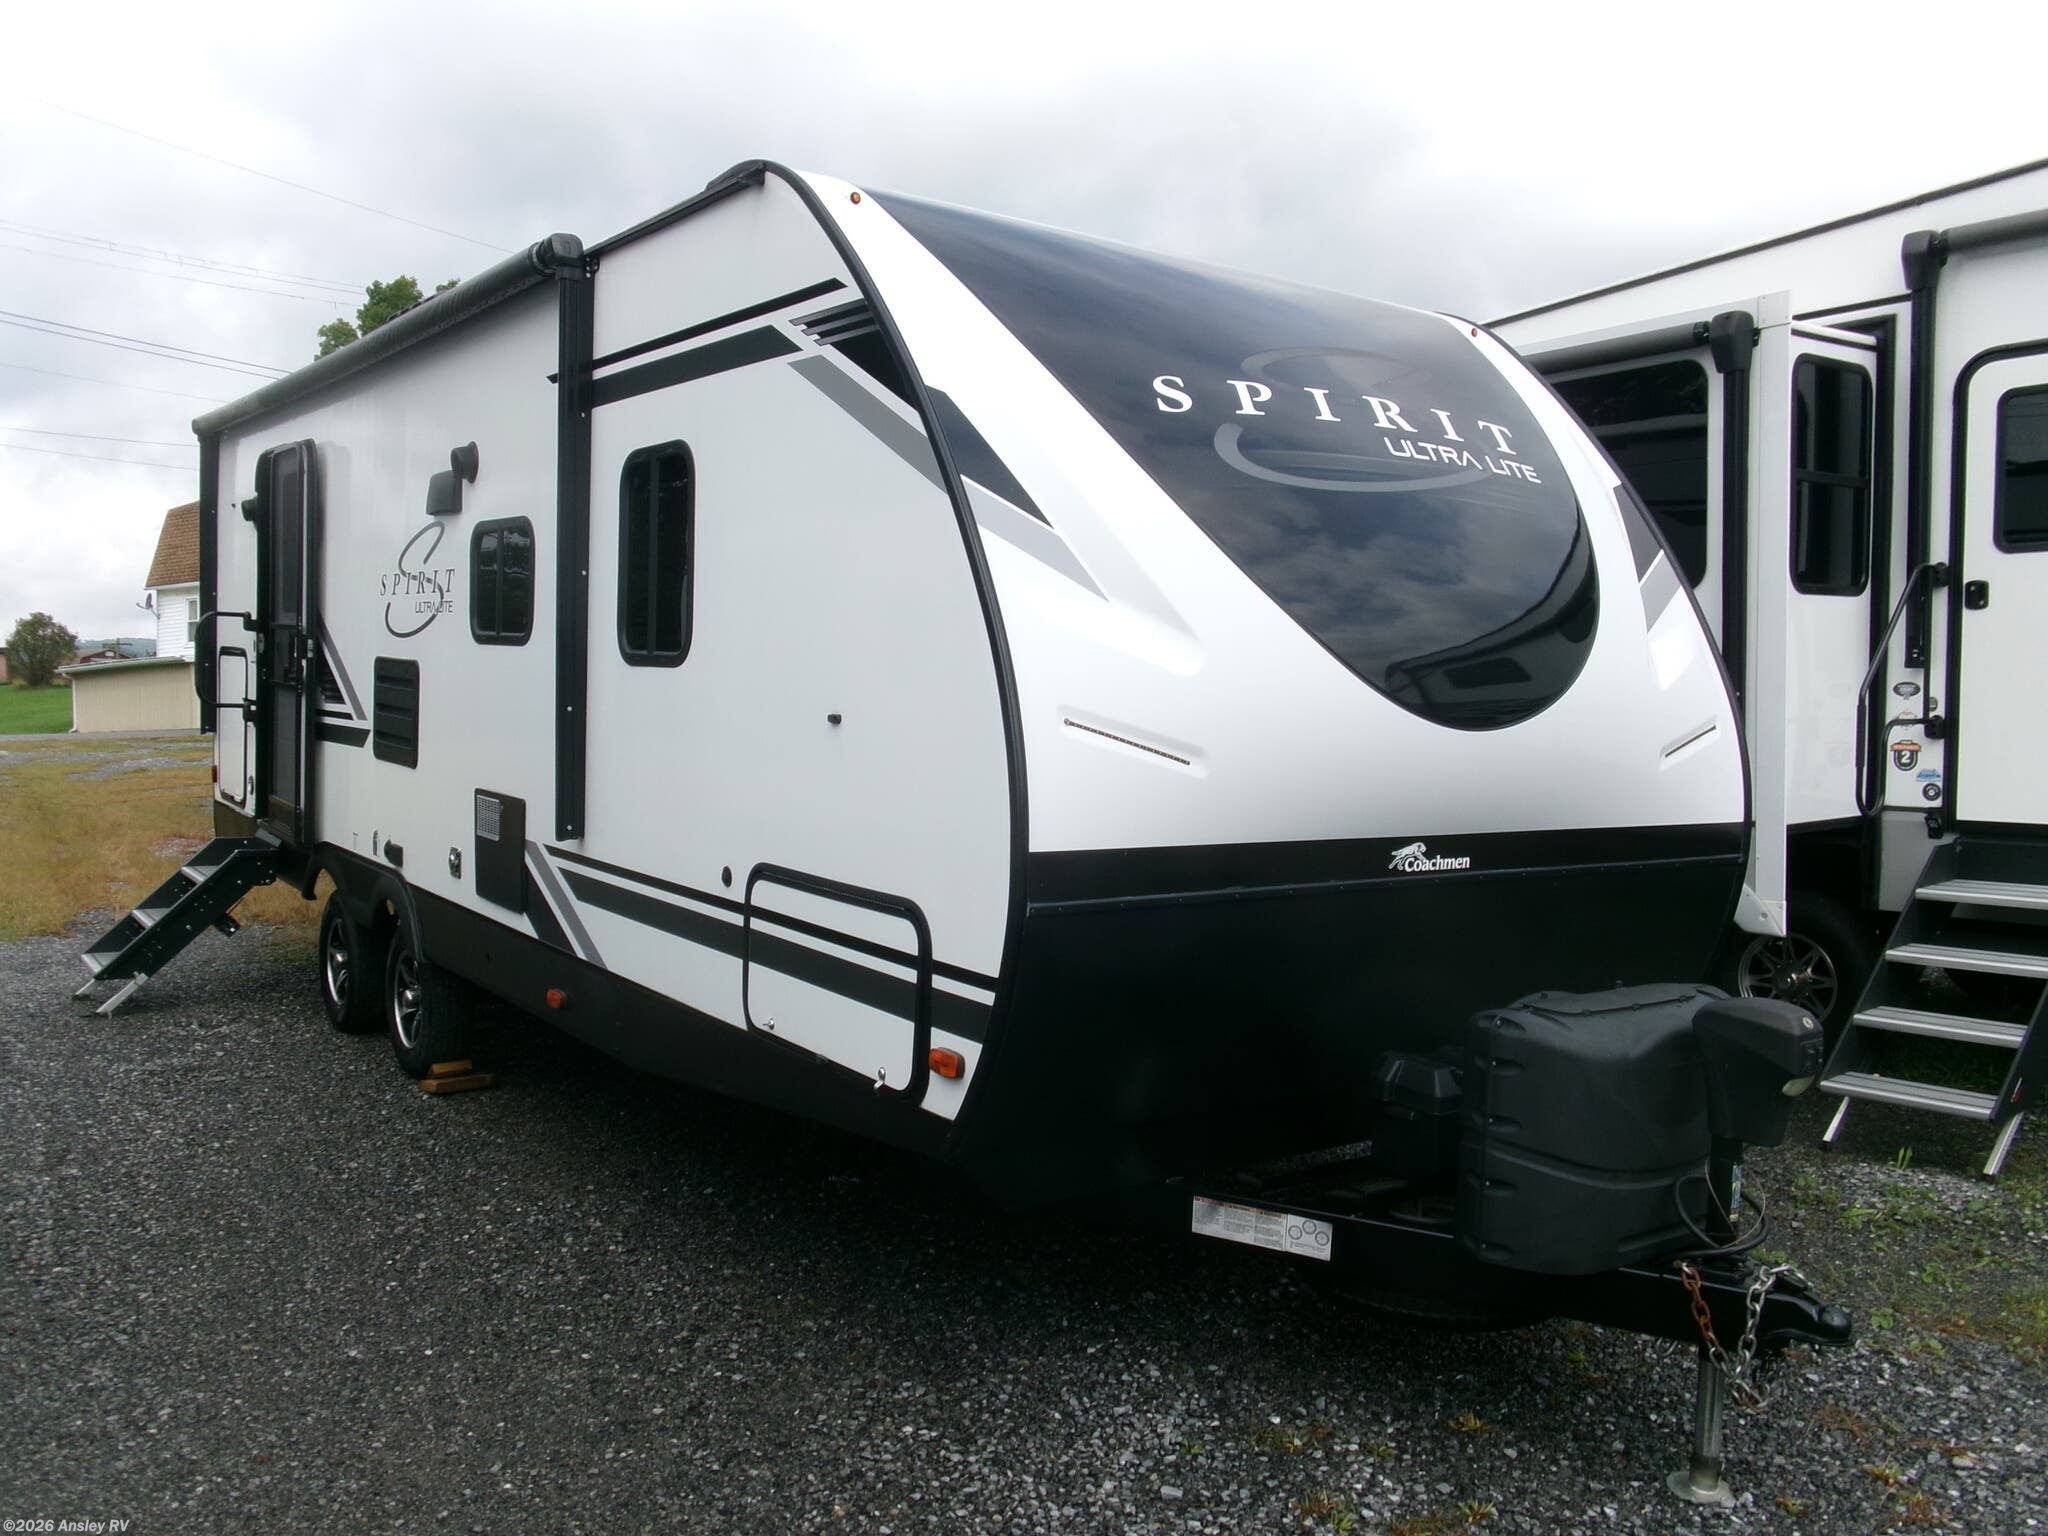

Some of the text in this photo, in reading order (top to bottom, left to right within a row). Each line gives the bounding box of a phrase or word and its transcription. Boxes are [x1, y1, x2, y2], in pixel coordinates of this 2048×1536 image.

[1152, 375, 1517, 455] SPIRIT
[1383, 436, 1543, 484] ULTRA LITE
[380, 568, 455, 596] SPIRIT
[415, 600, 438, 614] ULTRA
[1900, 750, 1912, 764] 2
[1404, 854, 1470, 872] Coachmen
